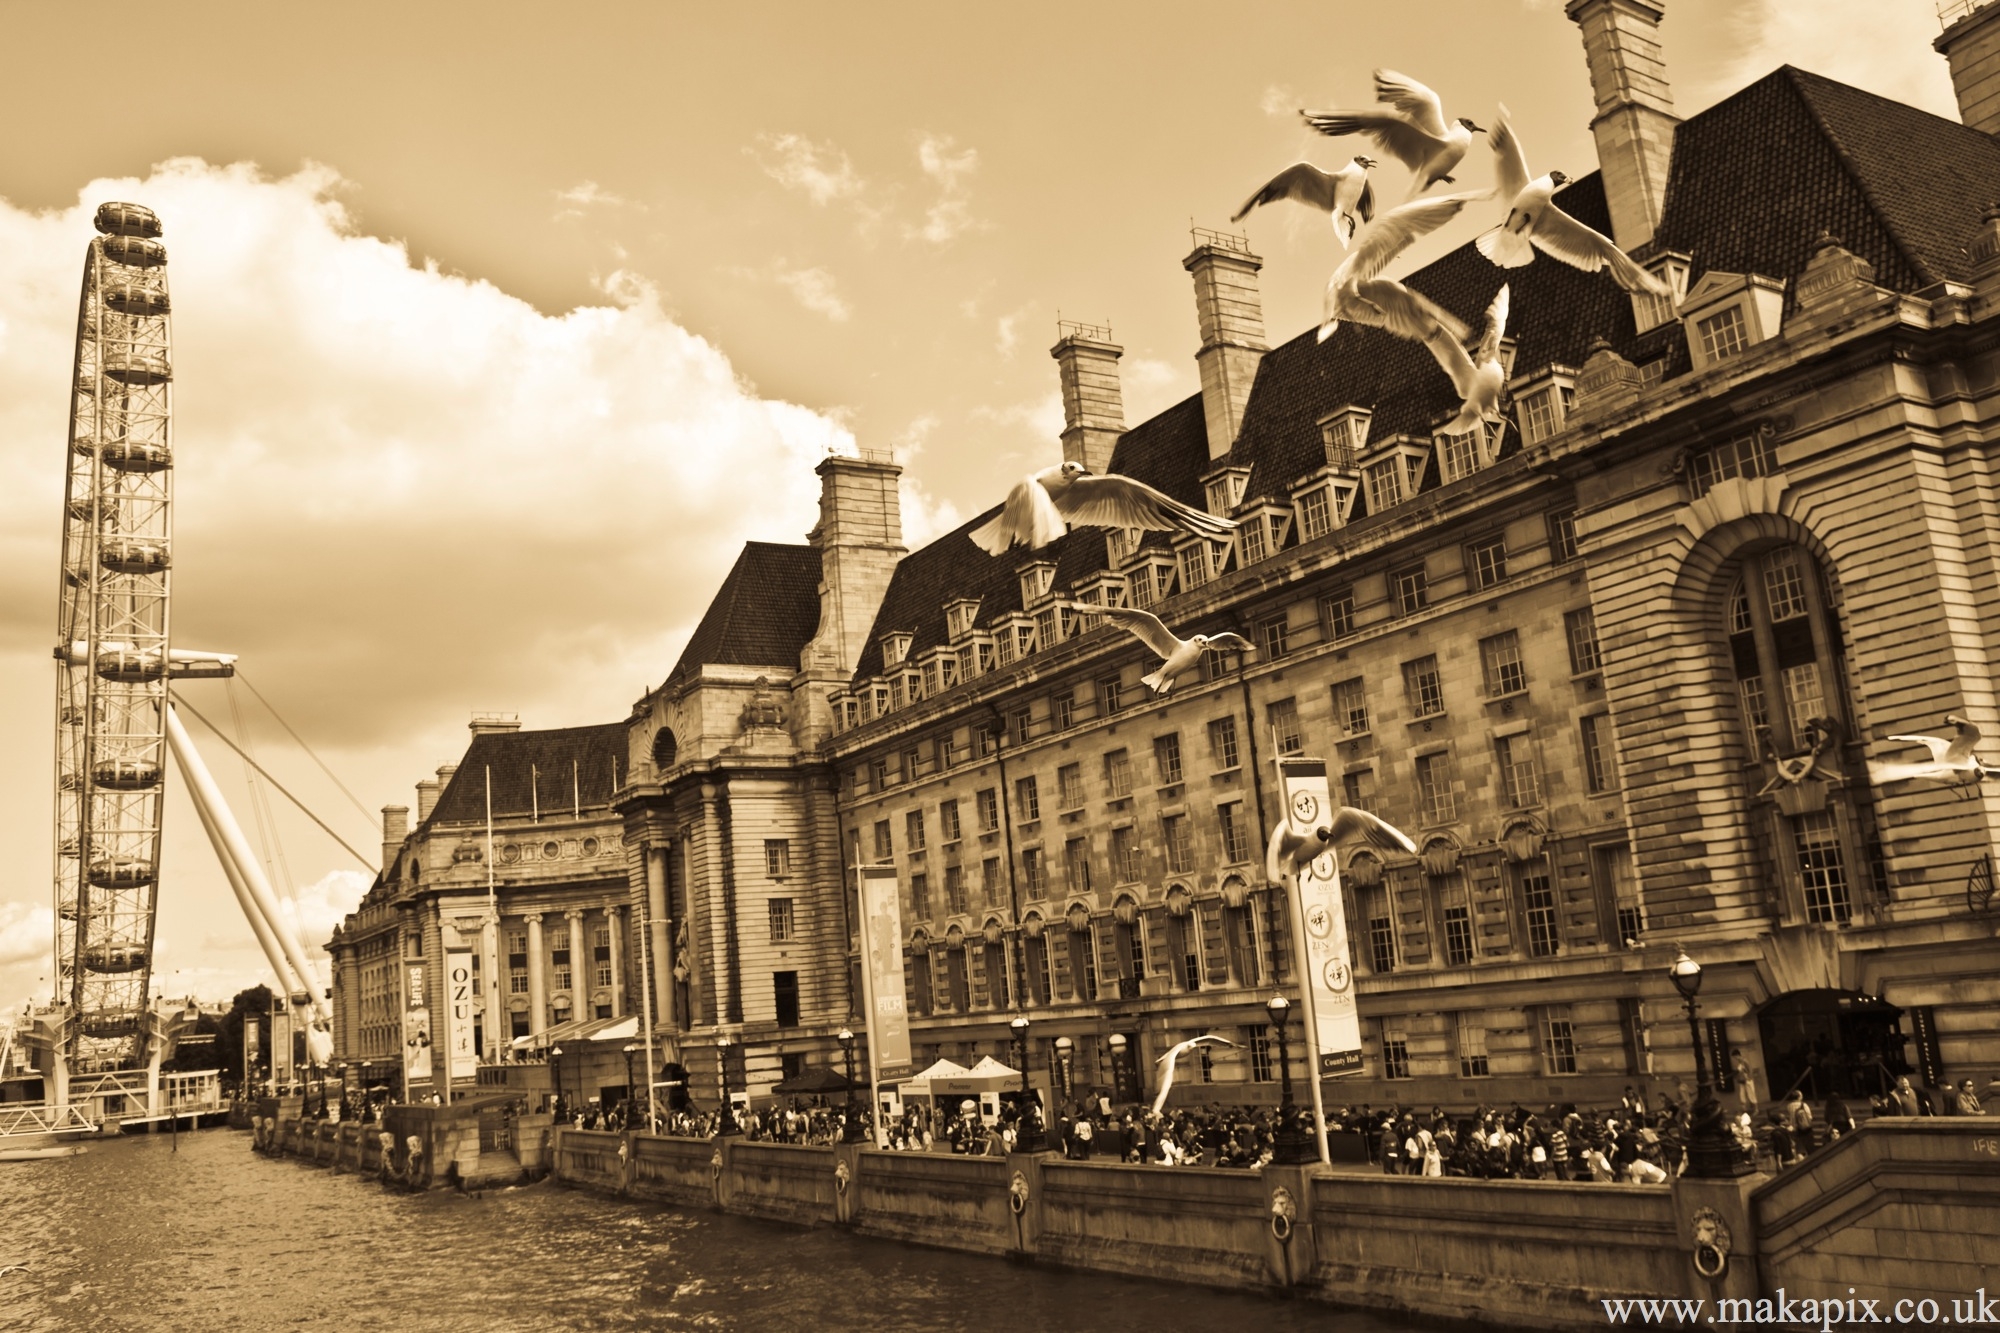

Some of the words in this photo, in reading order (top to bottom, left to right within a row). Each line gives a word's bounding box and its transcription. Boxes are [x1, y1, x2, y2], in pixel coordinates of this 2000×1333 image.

[1312, 941, 1329, 950] ZEN
[410, 987, 424, 1006] LIFE
[453, 968, 468, 1019] OZU
[1334, 995, 1350, 1004] ZEN
[877, 999, 903, 1011] FILM
[1324, 1058, 1346, 1067] County
[1346, 1054, 1359, 1064] Hall
[948, 1082, 972, 1090] Pioneer
